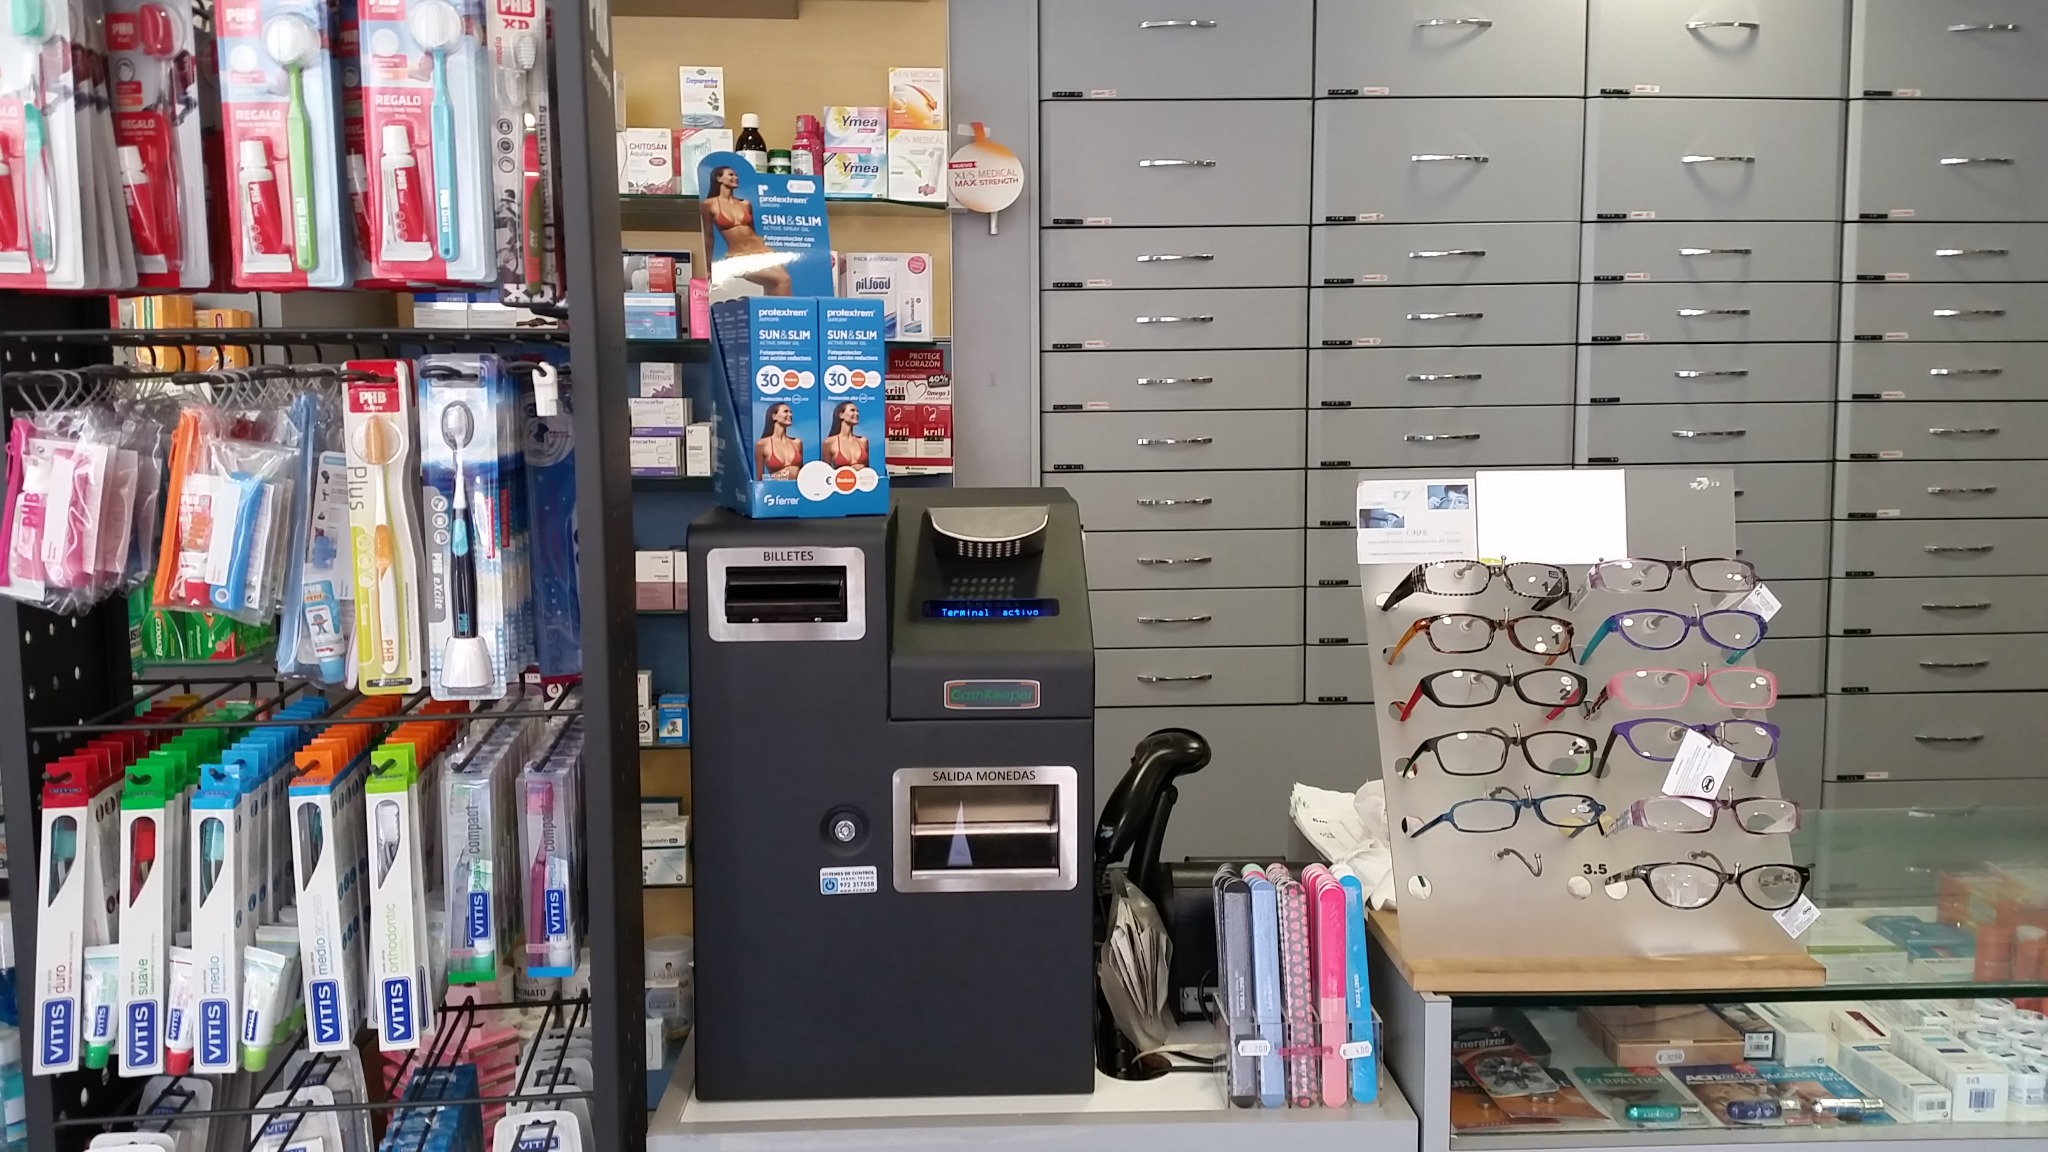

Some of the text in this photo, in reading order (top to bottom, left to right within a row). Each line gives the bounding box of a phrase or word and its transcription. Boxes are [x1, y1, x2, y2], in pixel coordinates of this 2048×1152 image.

[501, 0, 533, 15] PHB
[226, 8, 256, 22] PHB
[112, 23, 134, 35] PHB
[504, 19, 530, 30] XD
[375, 95, 422, 106] REGALO
[235, 110, 282, 121] REGALO
[842, 115, 878, 127] Ymea
[120, 119, 156, 129] REGALO
[629, 142, 668, 151] CHITOSÁN
[842, 162, 879, 173] Ymea
[978, 168, 1018, 178] MEDICAL
[954, 177, 1019, 187] MAX STRENGTH
[855, 276, 891, 293] pilfood
[758, 308, 809, 318] protextrem
[827, 308, 876, 318] protextrem
[758, 329, 811, 340] SUN&SLIM
[827, 329, 878, 340] SUN&SLIM
[909, 352, 941, 360] PROTEGE
[905, 358, 941, 368] CORAZÓN
[760, 373, 780, 387] 30
[828, 372, 847, 386] 30
[928, 374, 949, 383] 40%
[359, 391, 387, 404] PHB
[888, 427, 910, 436] krill
[923, 427, 945, 436] krill
[825, 476, 832, 486] €
[348, 466, 368, 511] Plus
[775, 494, 800, 506] ferrer
[763, 551, 814, 562] BILLETES
[431, 552, 443, 610] PHB eXcite
[941, 608, 1039, 617] Terminal activo
[155, 617, 163, 657] Berocca
[383, 639, 395, 663] PHB
[950, 688, 1033, 702] CashKeeper
[932, 770, 1036, 782] SALIDA MONEDAS
[540, 803, 557, 852] compact
[465, 804, 484, 889] suave compact
[1583, 863, 1608, 875] 3.5
[474, 894, 484, 937] VITIS
[550, 891, 560, 932] VITIS
[312, 894, 329, 975] medio access
[386, 903, 399, 974] orthodontic
[52, 964, 66, 994] duro
[138, 958, 149, 996] suave
[210, 955, 220, 994] medio
[1353, 973, 1361, 1009] BETER
[318, 984, 335, 1040] VITIS
[390, 982, 406, 1038] VITIS
[96, 1007, 107, 1036] VITIS
[169, 1010, 181, 1039] VITIS
[51, 1003, 65, 1061] VITIS
[135, 1005, 149, 1063] VITIS
[207, 1004, 221, 1060] VITIS
[1453, 1036, 1506, 1049] Energizer
